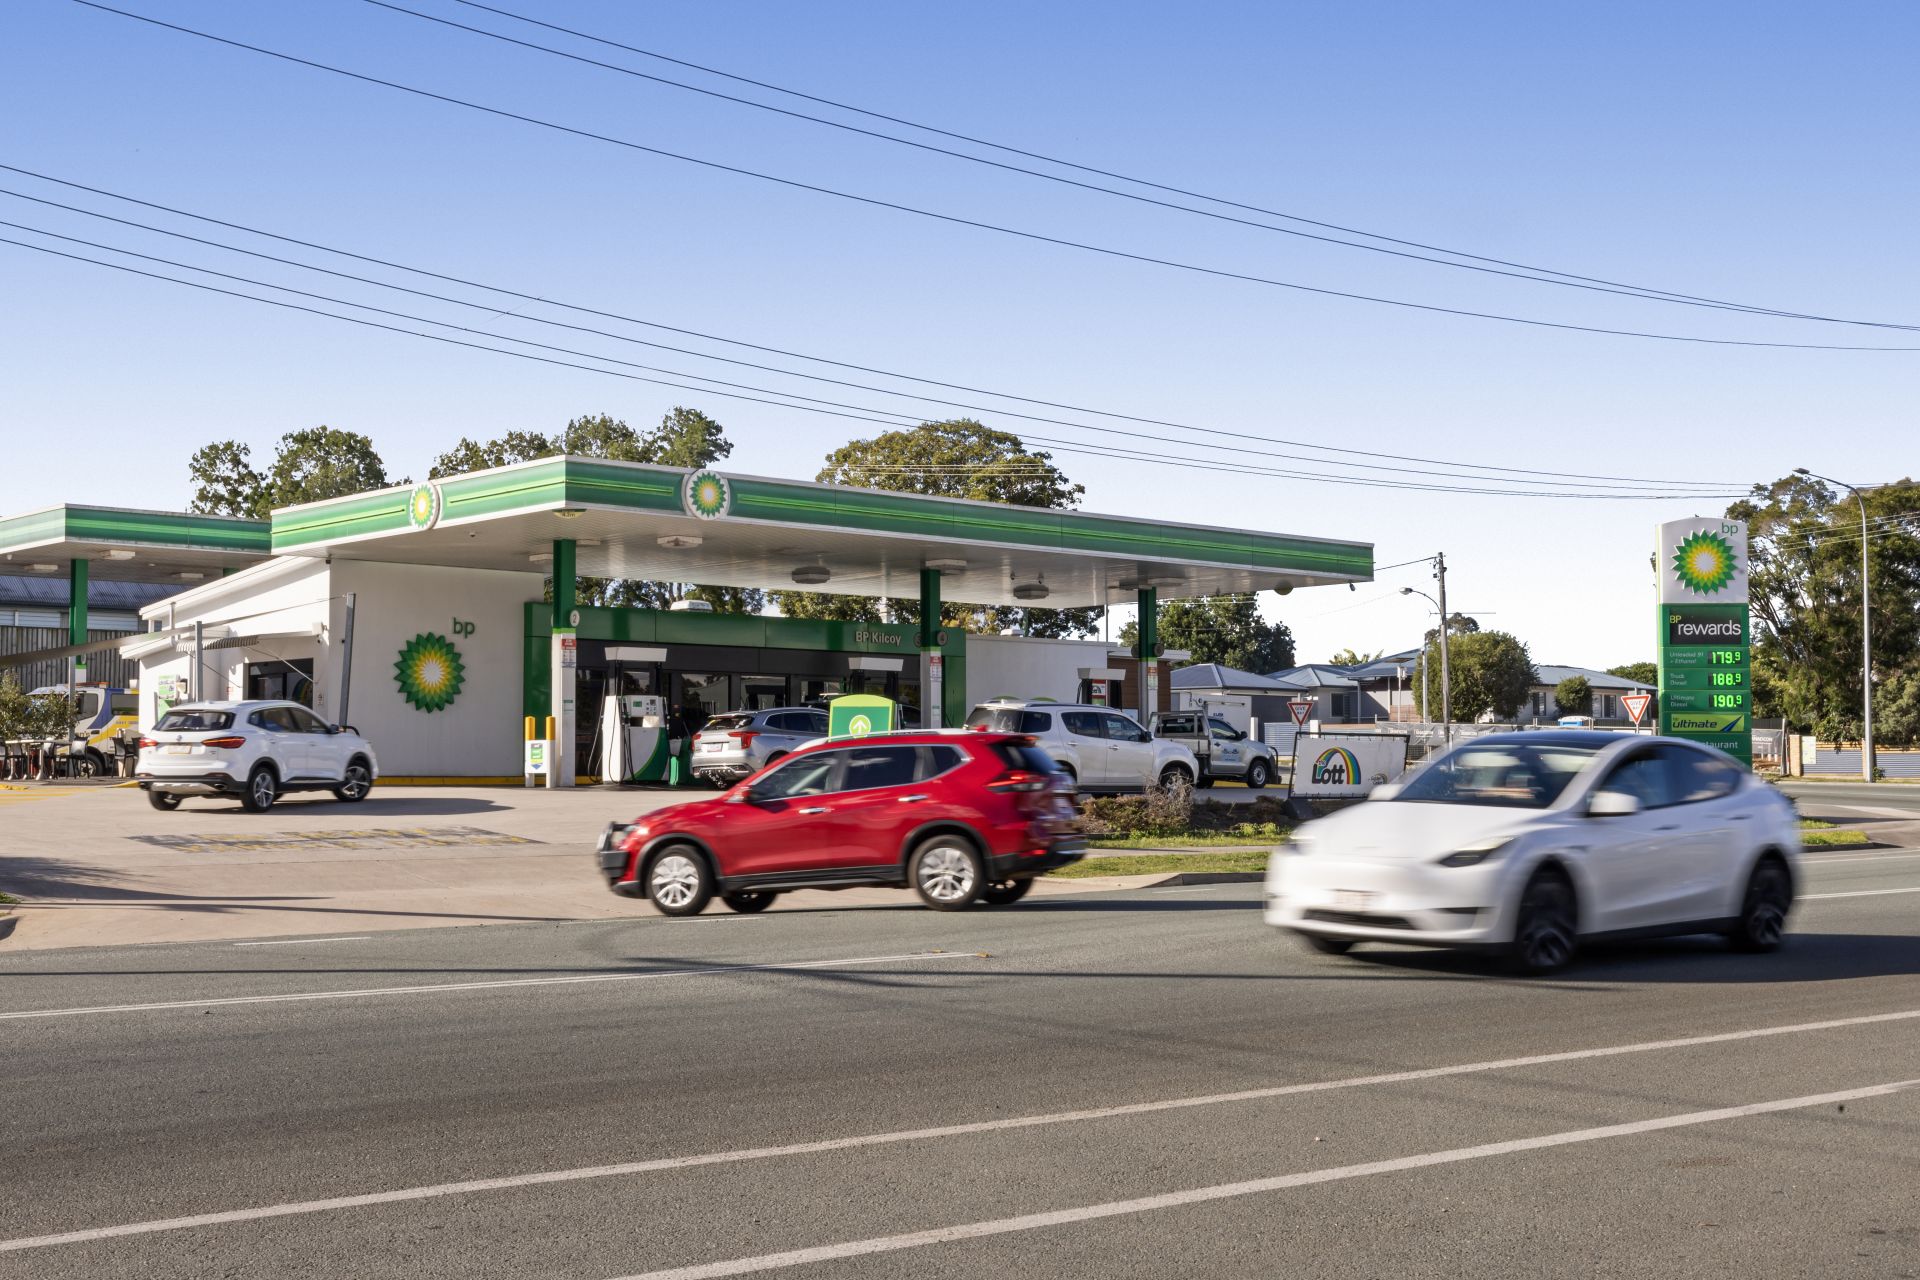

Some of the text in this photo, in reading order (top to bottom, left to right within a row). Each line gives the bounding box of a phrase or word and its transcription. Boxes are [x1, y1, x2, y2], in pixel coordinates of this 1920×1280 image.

[1721, 522, 1739, 537] bp
[572, 613, 578, 624] 2
[1670, 615, 1681, 624] BP
[453, 616, 475, 639] bp
[1678, 619, 1741, 635] rewards
[855, 631, 901, 646] BP Kilcoy
[1712, 651, 1741, 664] 179.9
[1712, 673, 1742, 686] 188.9
[1713, 694, 1742, 708] 190.9
[1672, 720, 1718, 729] ultimate
[1312, 763, 1345, 785] Lott
